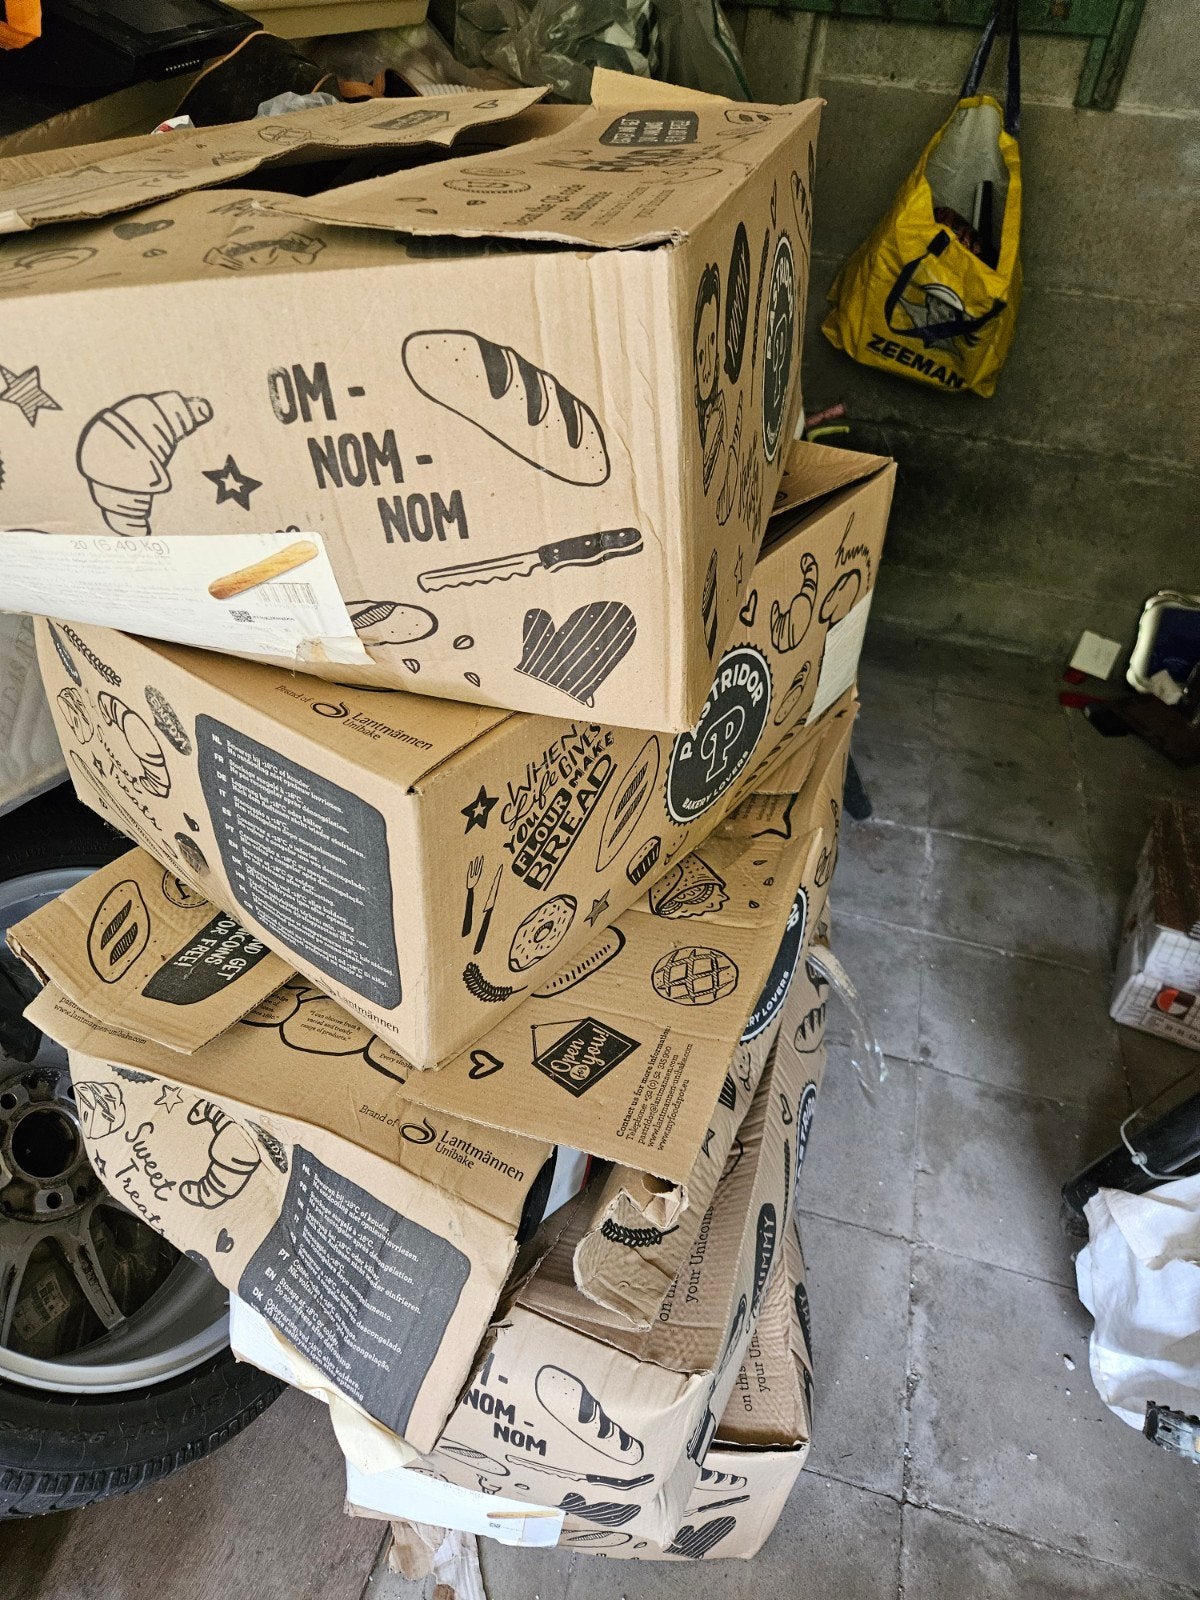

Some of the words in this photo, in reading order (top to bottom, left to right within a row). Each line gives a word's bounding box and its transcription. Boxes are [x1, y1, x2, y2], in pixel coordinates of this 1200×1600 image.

[866, 334, 966, 389] ZEEMAN
[267, 362, 337, 425] OM
[307, 429, 405, 489] NOM
[377, 489, 469, 543] NOM
[342, 718, 381, 741] Unibake
[352, 712, 434, 751] Lantmännen
[569, 731, 614, 788] MAKE
[682, 792, 712, 810] BAKERY
[713, 750, 749, 798] LOVERS
[516, 789, 570, 872] FLOUR
[523, 754, 612, 890] BREAD
[217, 957, 247, 981] GET
[762, 970, 790, 1017] LOVERS
[550, 1038, 585, 1073] Open
[582, 1027, 610, 1066] you!
[647, 1023, 672, 1065] information:
[633, 1083, 644, 1096] for
[640, 1064, 652, 1084] more
[359, 1104, 388, 1123] Brand
[386, 1117, 400, 1128] of
[631, 1096, 639, 1106] us
[615, 1105, 634, 1138] Contact
[625, 1102, 648, 1141] Telephone:
[125, 1121, 176, 1202] Sweet
[435, 1143, 475, 1169] Unibake
[441, 1130, 524, 1182] Lantmännen
[278, 1246, 289, 1263] PT
[252, 1285, 263, 1302] DK
[265, 1265, 276, 1281] EN
[279, 1276, 299, 1302] Storage
[274, 1283, 284, 1297] Do
[282, 1292, 292, 1306] not
[686, 1269, 701, 1304] your
[659, 1301, 673, 1322] on
[759, 1361, 771, 1394] your
[463, 1388, 516, 1426] NOM
[742, 1395, 753, 1412] on
[493, 1422, 547, 1457] NOM
